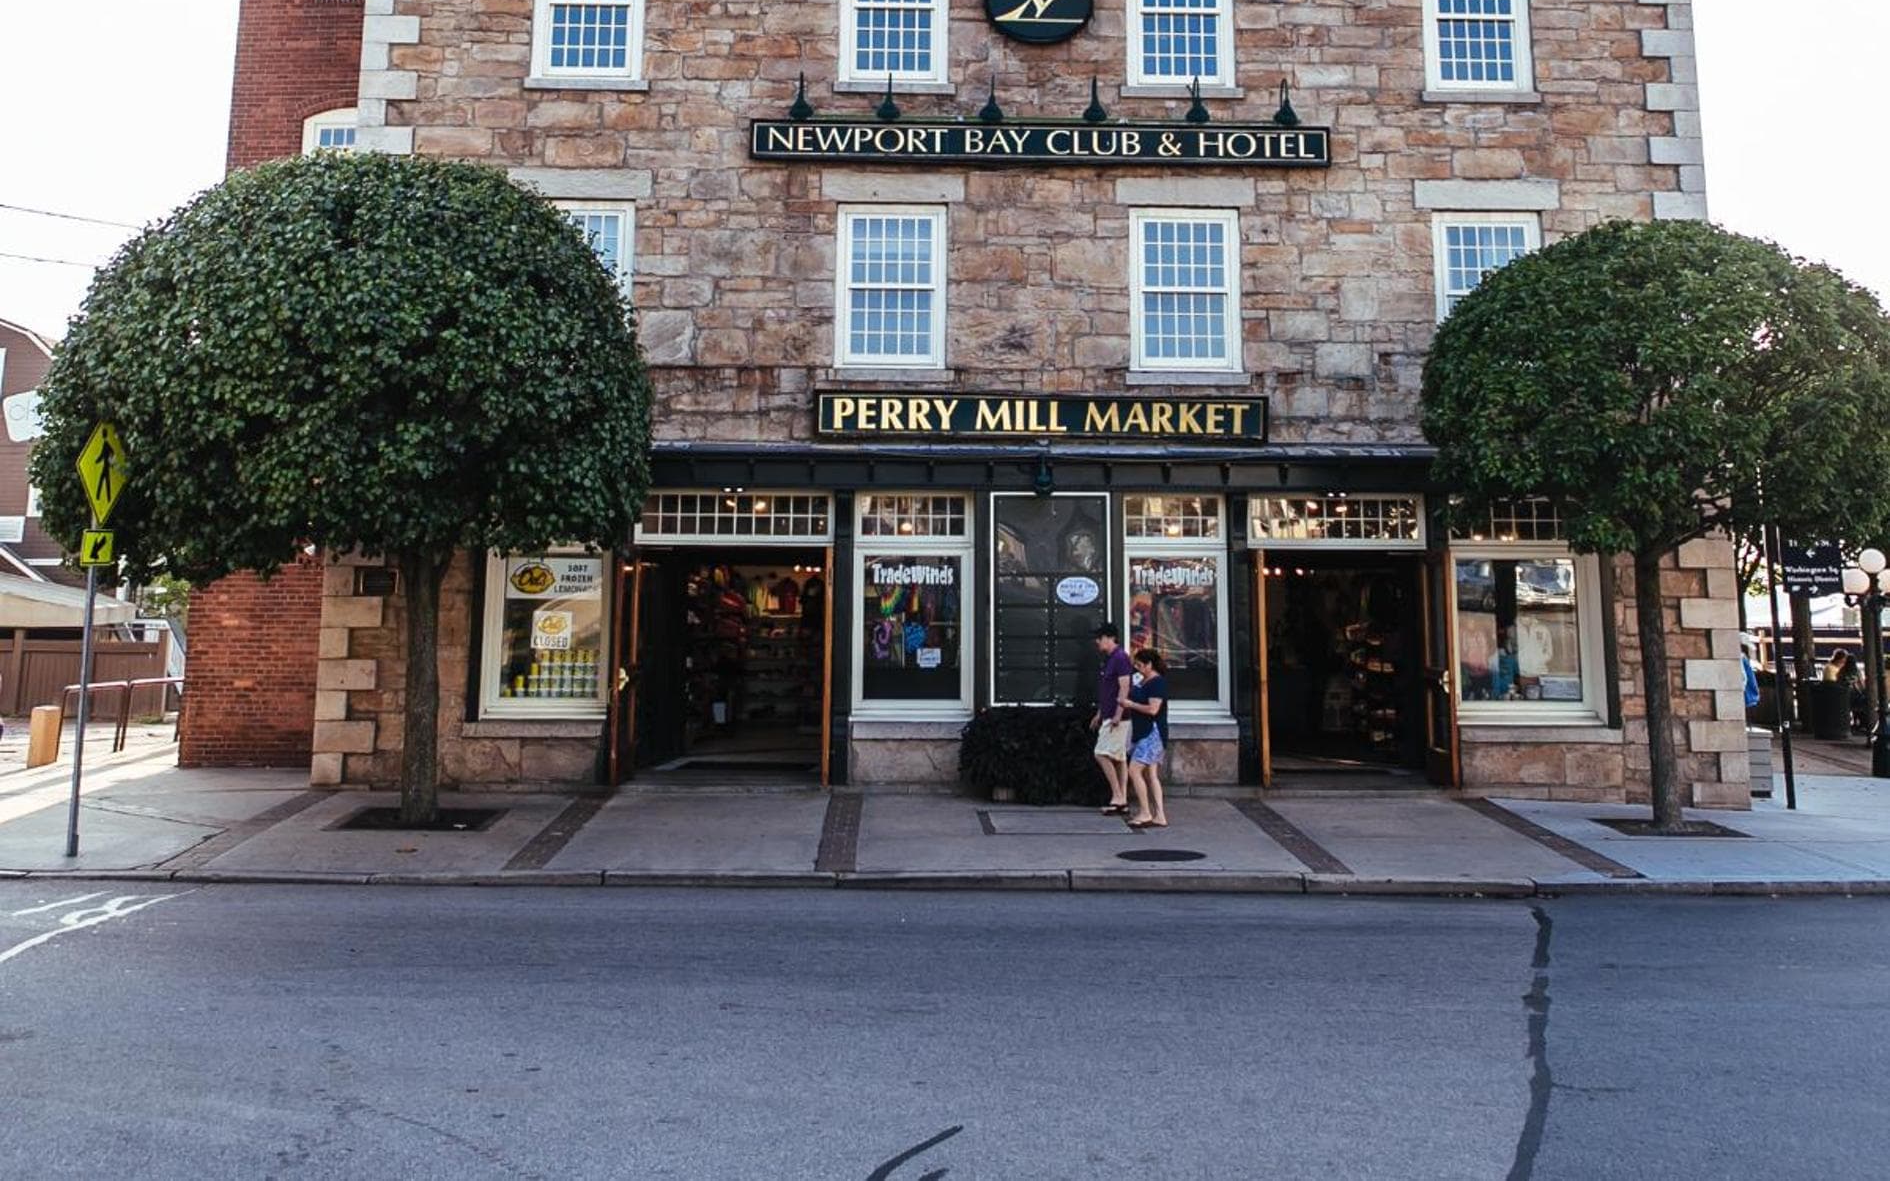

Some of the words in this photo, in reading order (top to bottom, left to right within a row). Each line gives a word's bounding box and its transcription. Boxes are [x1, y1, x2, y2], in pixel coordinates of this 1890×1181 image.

[768, 126, 949, 153] NEWPORT
[964, 128, 1031, 154] BAY
[1046, 130, 1141, 155] CLUB
[1157, 132, 1182, 157] &
[1198, 132, 1316, 159] HOTEL
[832, 398, 959, 431] PERRY
[974, 399, 1067, 432] MILL
[1084, 401, 1251, 436] MARKET
[567, 564, 588, 573] SOFT
[1784, 565, 1827, 575] Washington
[561, 574, 593, 583] FROZEN
[533, 635, 568, 647] CLOSED
